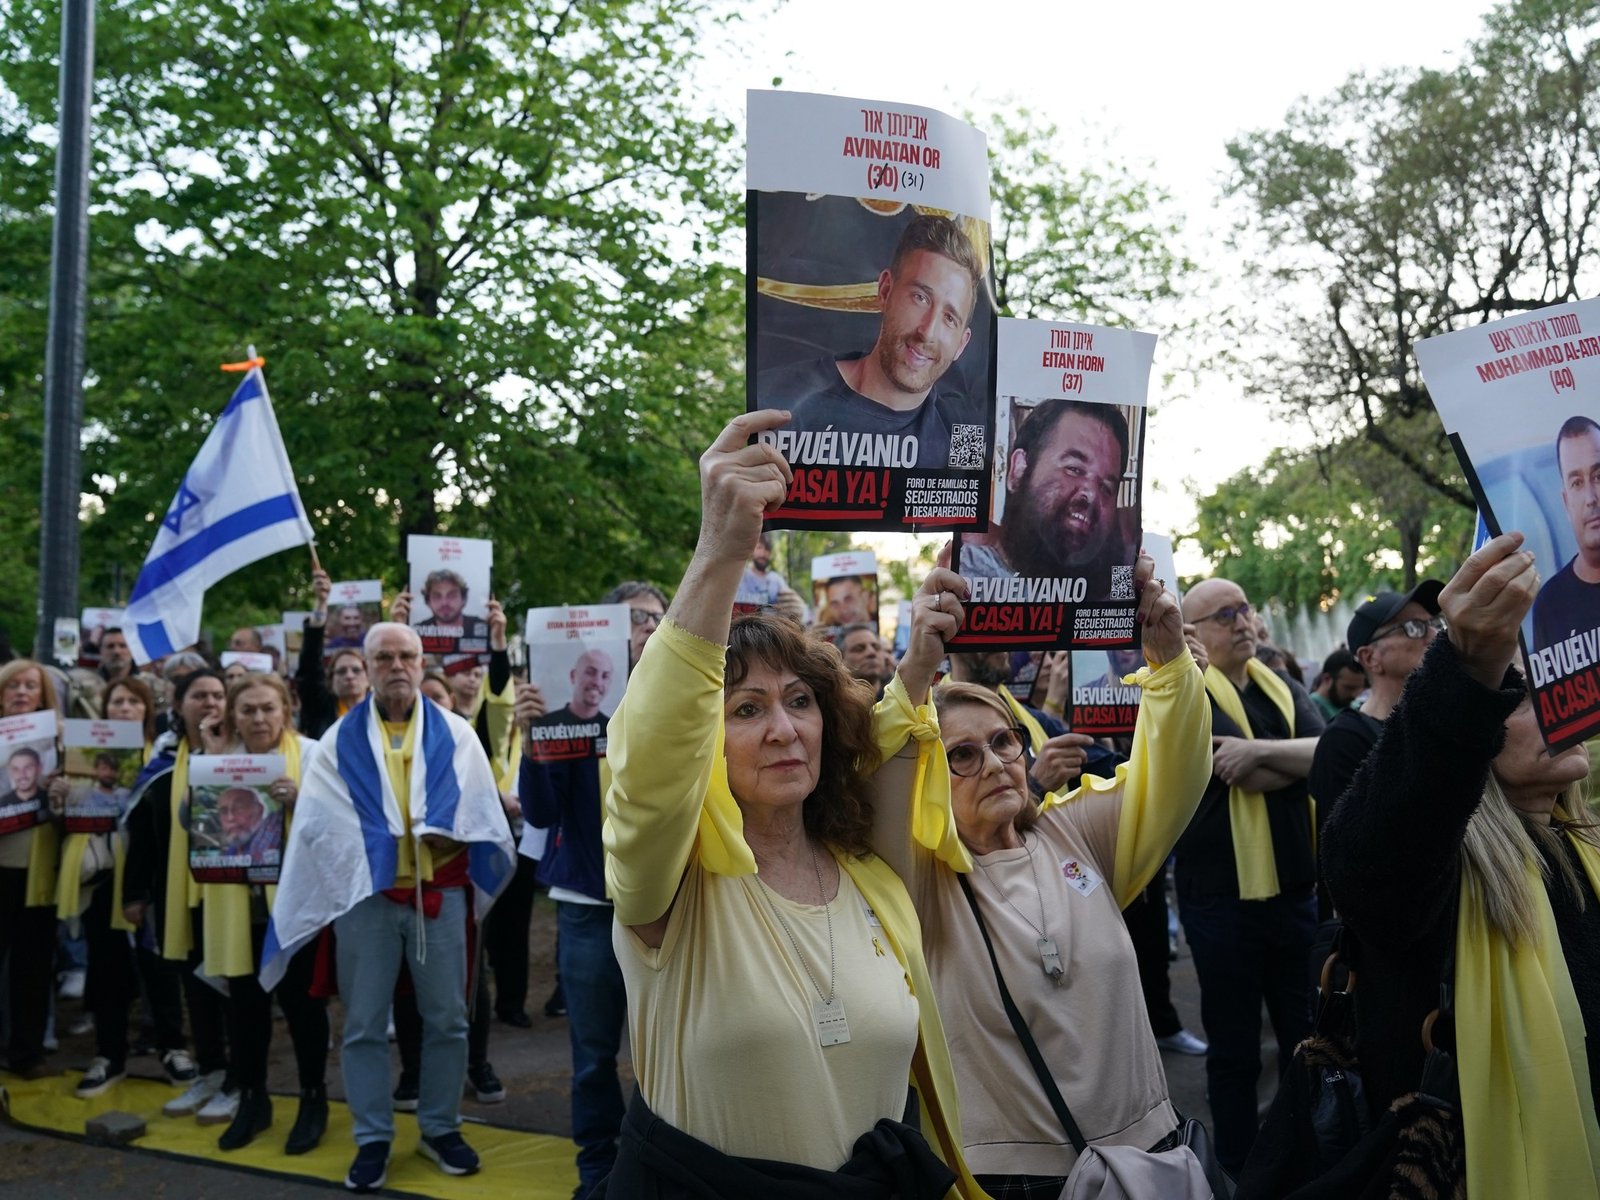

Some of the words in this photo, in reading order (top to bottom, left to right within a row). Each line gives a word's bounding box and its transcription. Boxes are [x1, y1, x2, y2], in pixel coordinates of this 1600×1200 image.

[860, 109, 883, 134] אור
[843, 136, 920, 166] AVINATAN
[922, 146, 940, 169] OR
[901, 170, 924, 191] (31)
[1050, 329, 1071, 349] הורן
[1073, 331, 1093, 351] איתן
[1042, 351, 1075, 369] EITAN
[1076, 355, 1105, 372] HORN
[1475, 344, 1564, 384] MUHAMMAD
[1062, 372, 1083, 394] (37)
[1549, 366, 1576, 394] (40)
[785, 469, 838, 505] ASA
[845, 469, 891, 509] YA!
[906, 478, 925, 489] FORO
[927, 478, 936, 489] DE
[938, 478, 967, 490] FAMILIAS
[969, 479, 979, 490] DE
[904, 490, 978, 505] SECUESTRADOS
[904, 505, 910, 517] Y
[912, 506, 977, 518] DESAPARECIDOS
[970, 605, 1024, 631] CASA
[1073, 617, 1134, 630] SECUESTRADOS
[1075, 609, 1091, 618] FORO
[1092, 609, 1100, 617] DE
[1100, 609, 1126, 617] FAMILIAS
[1127, 608, 1135, 617] DE
[1073, 630, 1079, 640] Y
[1079, 629, 1133, 640] DESAPARECIDOS
[1528, 627, 1600, 689] DEVUÉLV
[1538, 691, 1557, 727] A
[1552, 669, 1600, 720] CASA
[1073, 706, 1082, 724] A
[1084, 706, 1116, 724] CASA
[531, 722, 600, 740] DEVUÉLVANLO
